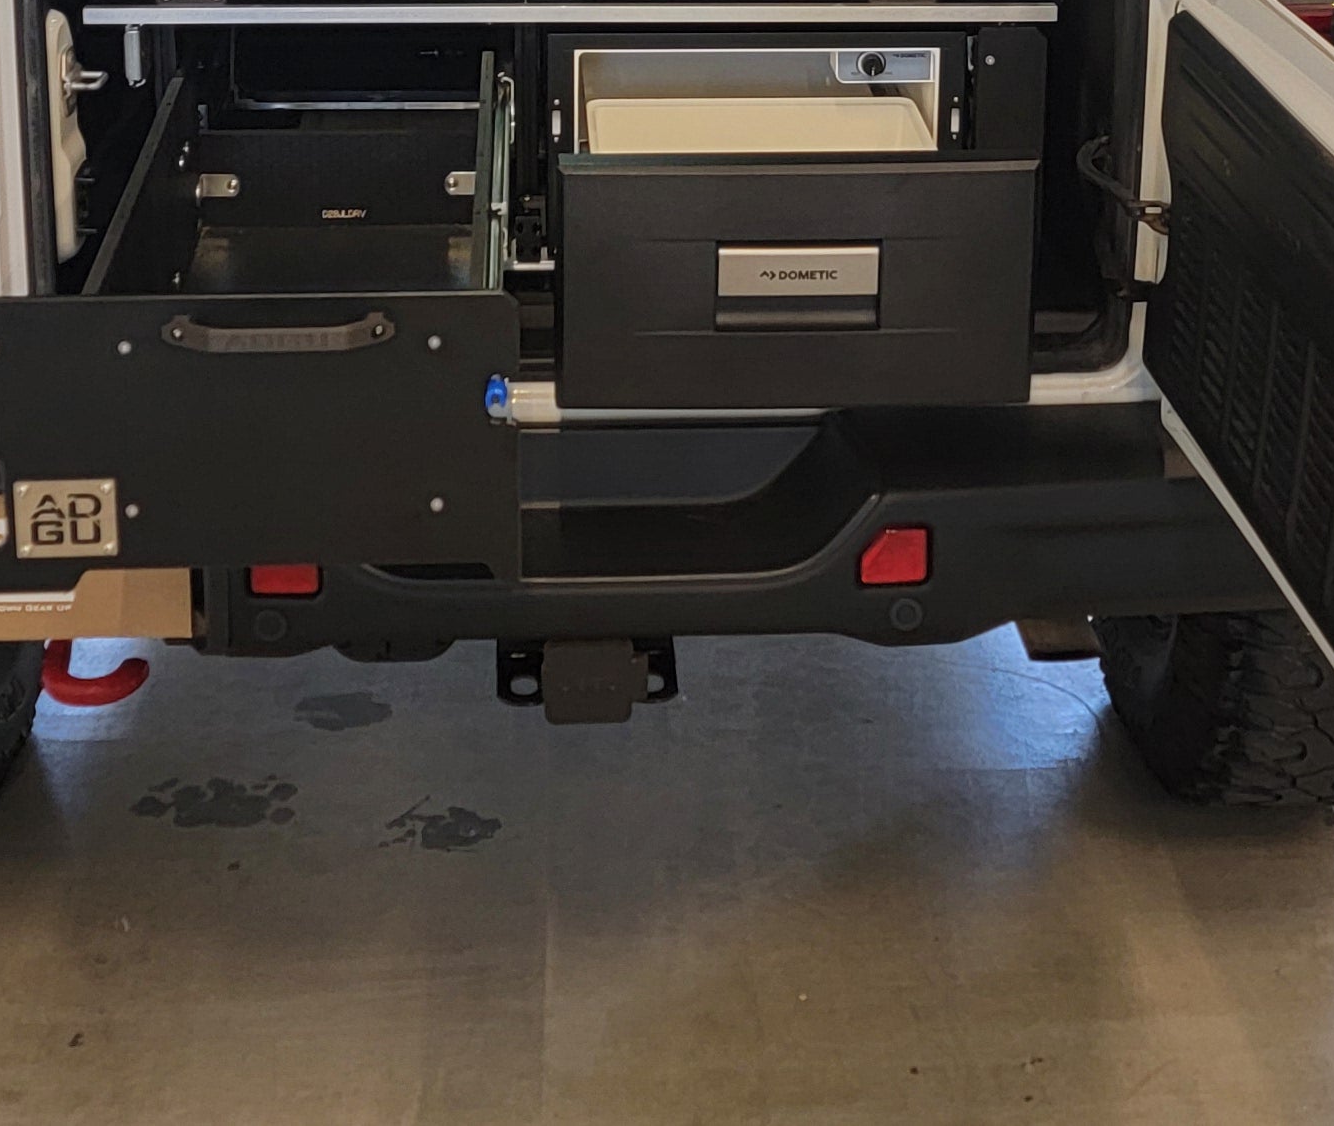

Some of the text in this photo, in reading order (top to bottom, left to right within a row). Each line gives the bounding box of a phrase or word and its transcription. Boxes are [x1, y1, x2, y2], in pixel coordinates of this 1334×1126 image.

[779, 270, 838, 280] DOMETIC
[31, 493, 102, 519] AD
[31, 520, 102, 545] GU
